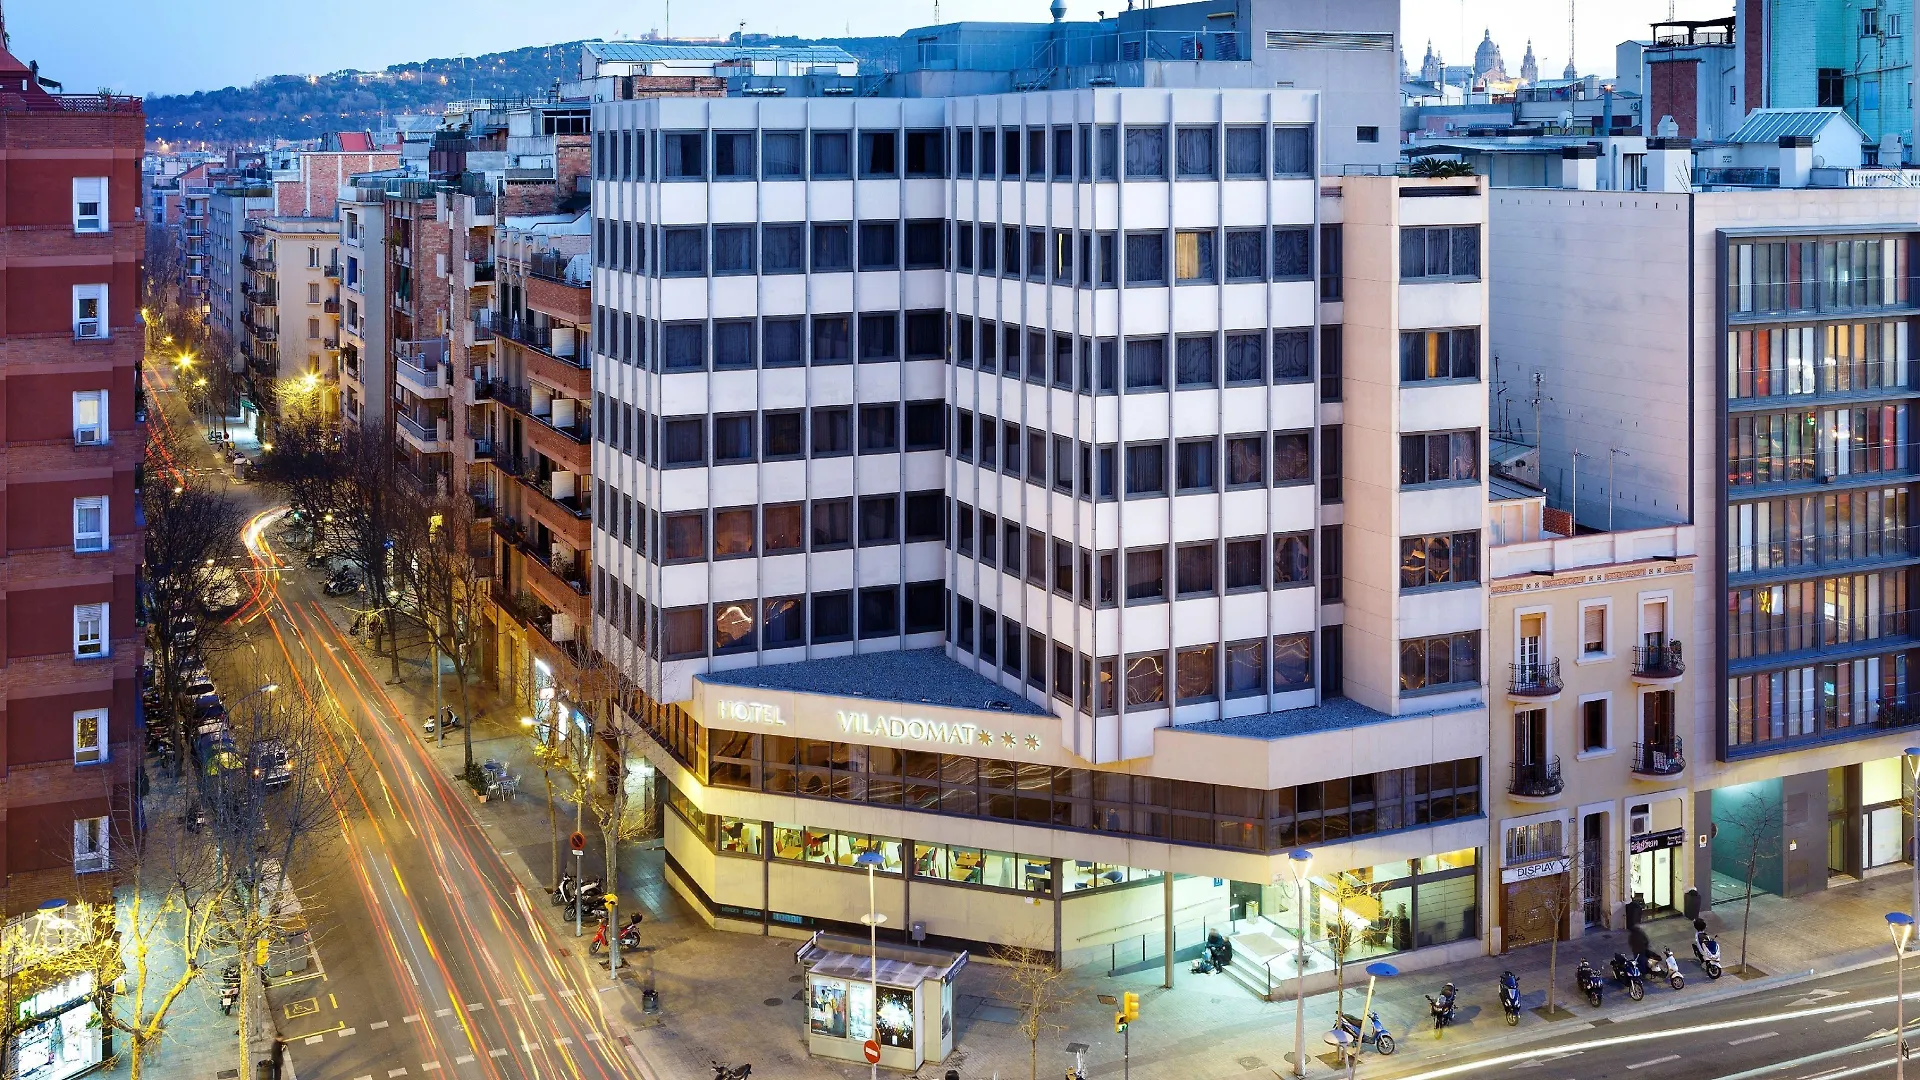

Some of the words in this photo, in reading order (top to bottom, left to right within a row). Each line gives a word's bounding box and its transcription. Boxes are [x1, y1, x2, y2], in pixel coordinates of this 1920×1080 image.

[718, 700, 785, 725] HOTEL
[837, 710, 976, 745] VILADOMAT
[1517, 862, 1555, 877] DISPLAY
